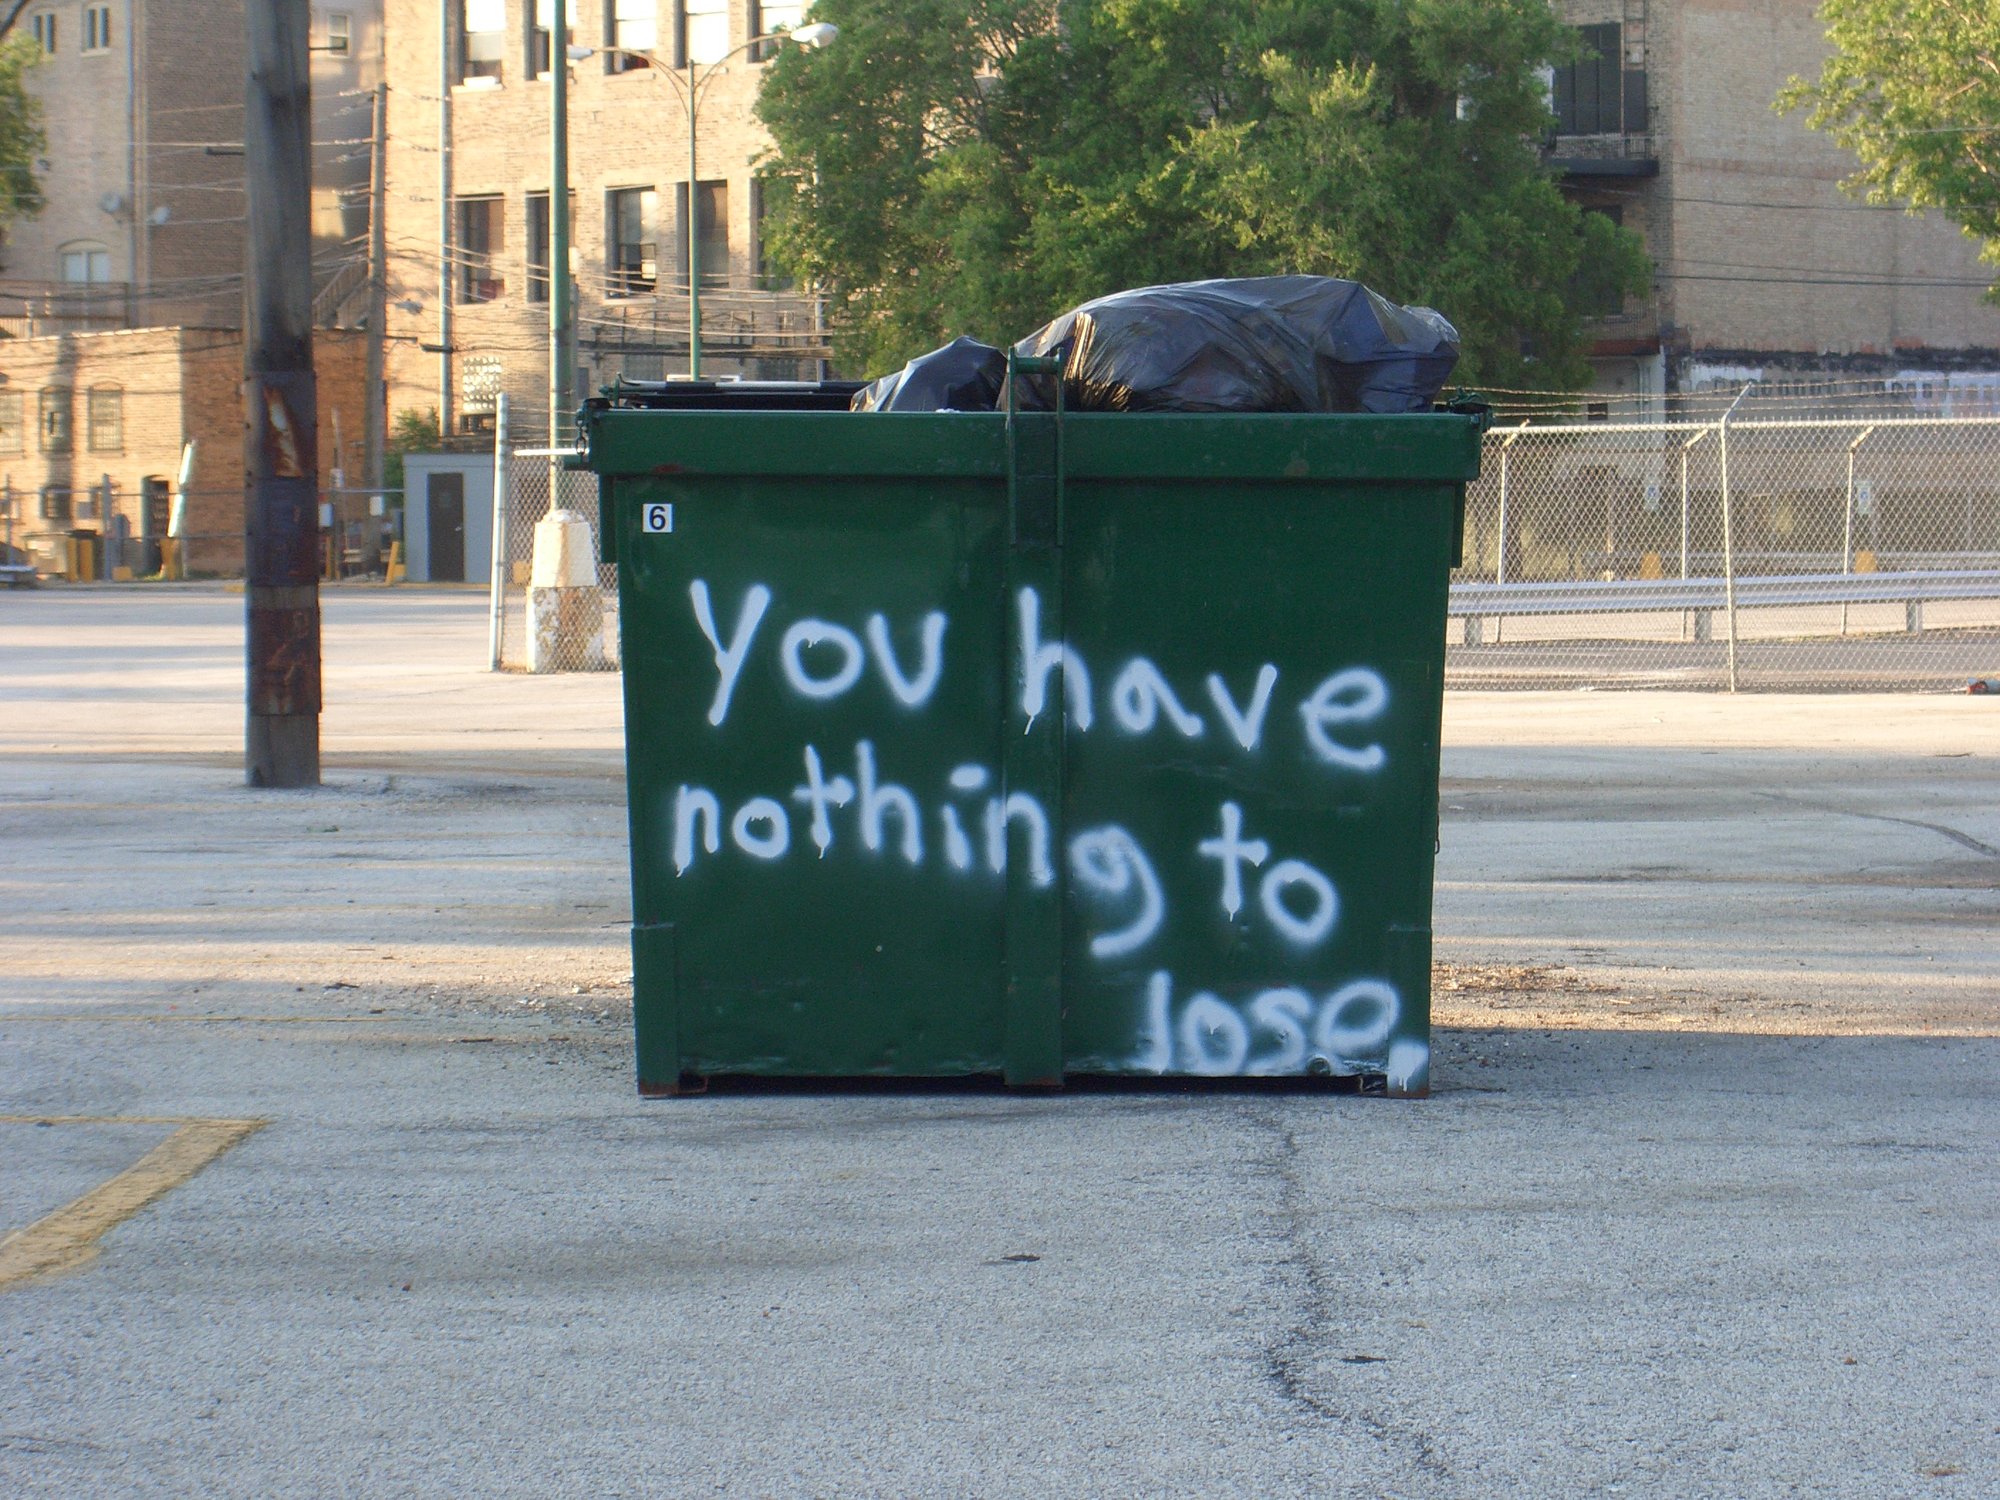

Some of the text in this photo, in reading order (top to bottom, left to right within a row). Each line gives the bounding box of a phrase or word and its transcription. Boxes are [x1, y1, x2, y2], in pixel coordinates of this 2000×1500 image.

[648, 504, 667, 531] 6
[688, 578, 1390, 772] you have
[672, 740, 1339, 958] nothing to
[1142, 968, 1430, 1092] lose.
